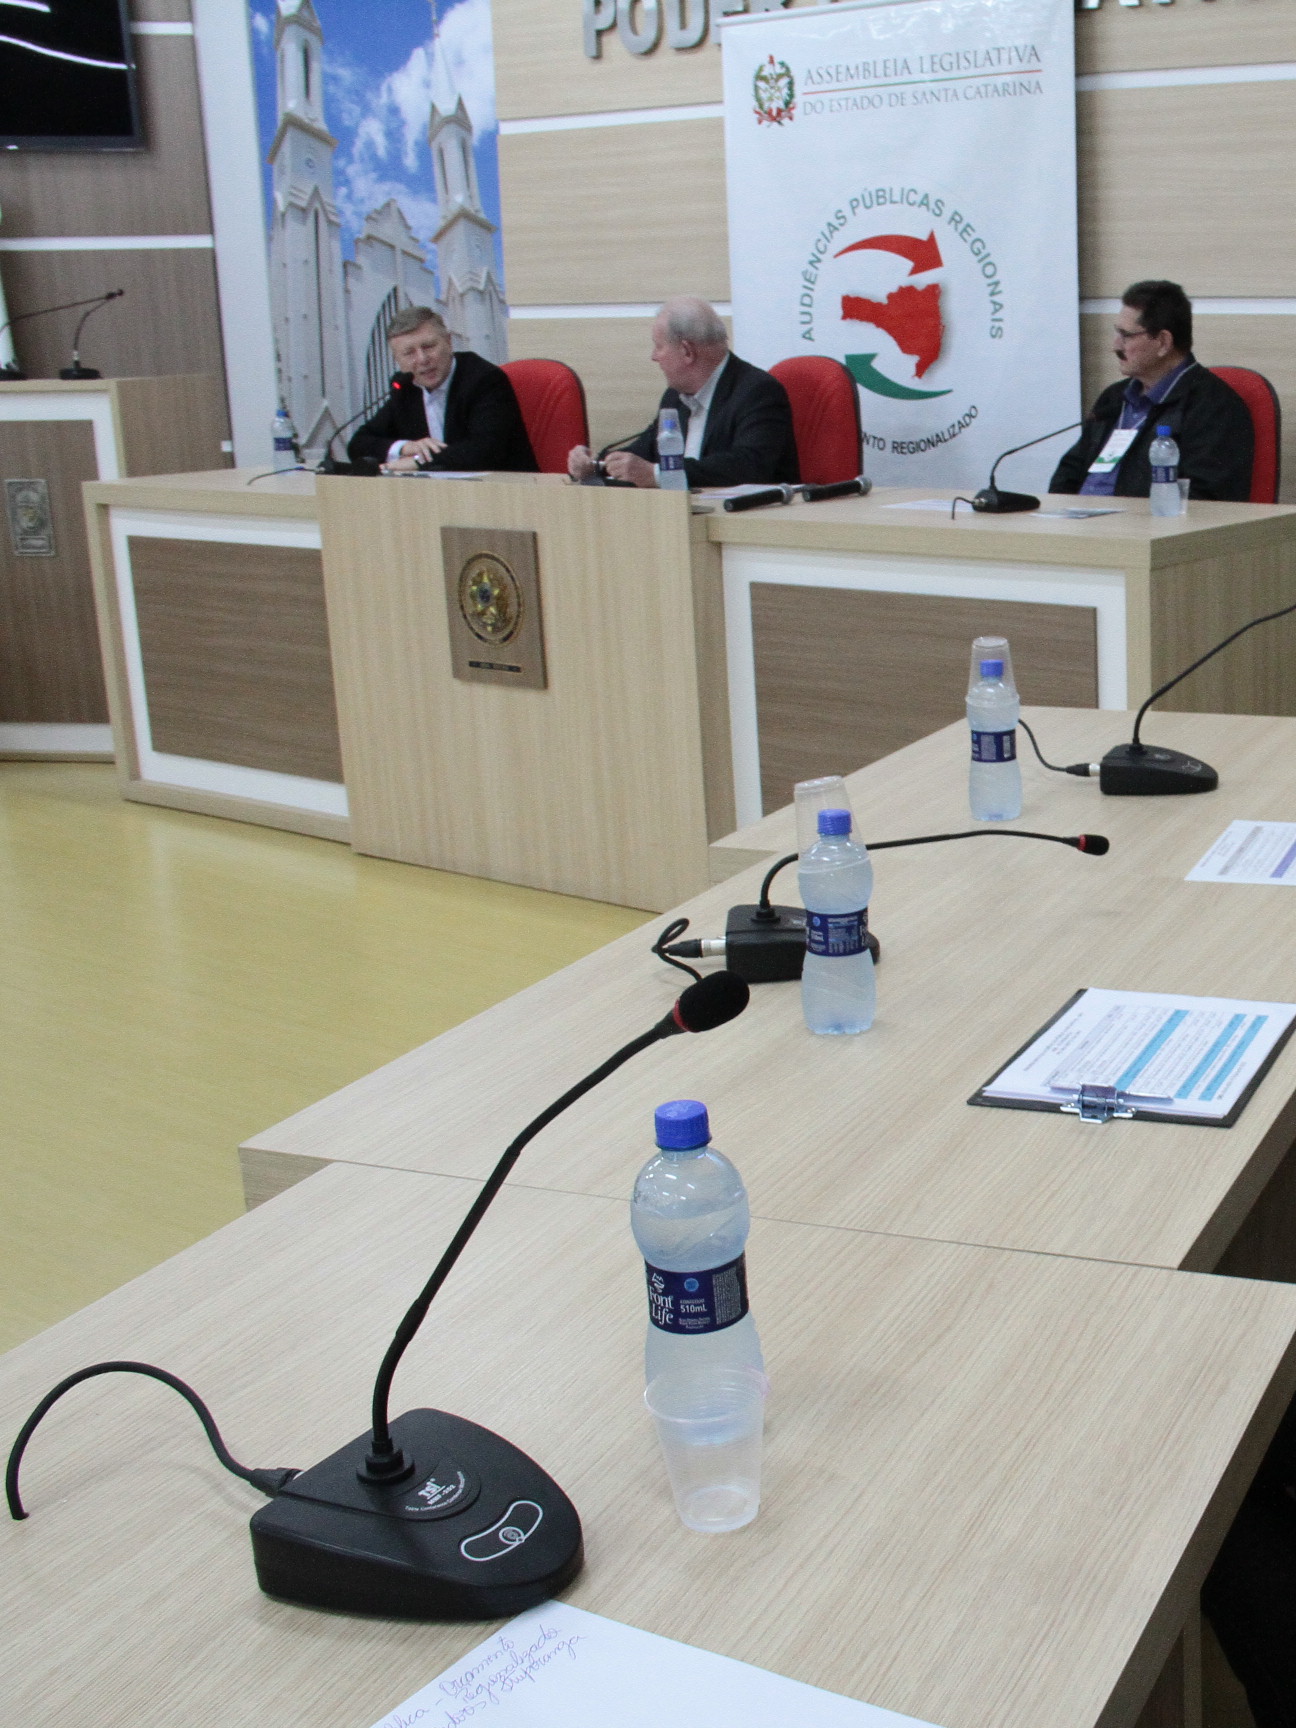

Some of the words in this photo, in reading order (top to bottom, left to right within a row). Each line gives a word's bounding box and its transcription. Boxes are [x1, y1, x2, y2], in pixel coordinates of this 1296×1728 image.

[803, 58, 913, 86] ASSEMBLEIA
[918, 45, 1041, 74] LEGISLATIVA
[803, 98, 826, 116] DO
[830, 94, 884, 113] ESTADO
[887, 91, 908, 108] DE
[911, 87, 961, 105] SANTA
[963, 79, 1043, 101] CATARINA
[799, 209, 848, 342] AUDIÊNCIAS
[849, 186, 946, 218] PÚBLICAS
[948, 210, 1004, 340] REGIONAIS
[891, 404, 978, 455] REGIONALIZADO
[652, 1302, 674, 1325] Life
